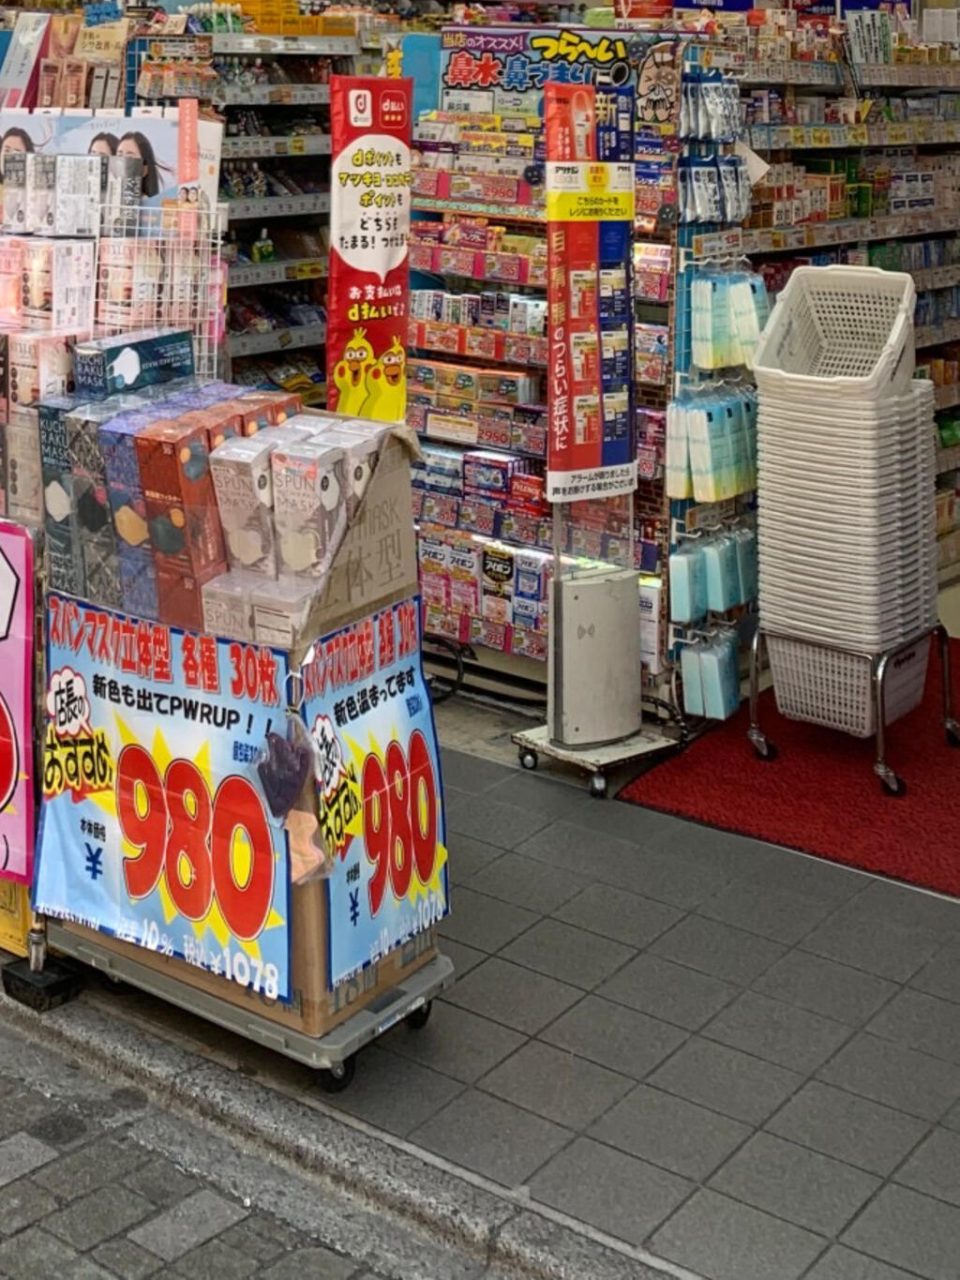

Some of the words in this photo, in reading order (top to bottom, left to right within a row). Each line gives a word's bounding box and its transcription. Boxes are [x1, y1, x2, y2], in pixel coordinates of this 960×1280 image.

[442, 31, 524, 51] 当店のオススメ!
[77, 375, 105, 387] MASK
[275, 474, 317, 491] SPUN
[48, 596, 172, 684] スパンマスク立体型
[181, 632, 221, 695] 各種
[229, 640, 281, 707] 30枚
[54, 678, 86, 728] 店長の
[332, 665, 417, 728] 新色温まってます
[116, 743, 276, 941] 980
[361, 728, 439, 920] 980
[85, 842, 104, 881] ¥
[348, 886, 361, 928] ¥
[141, 918, 160, 952] 10
